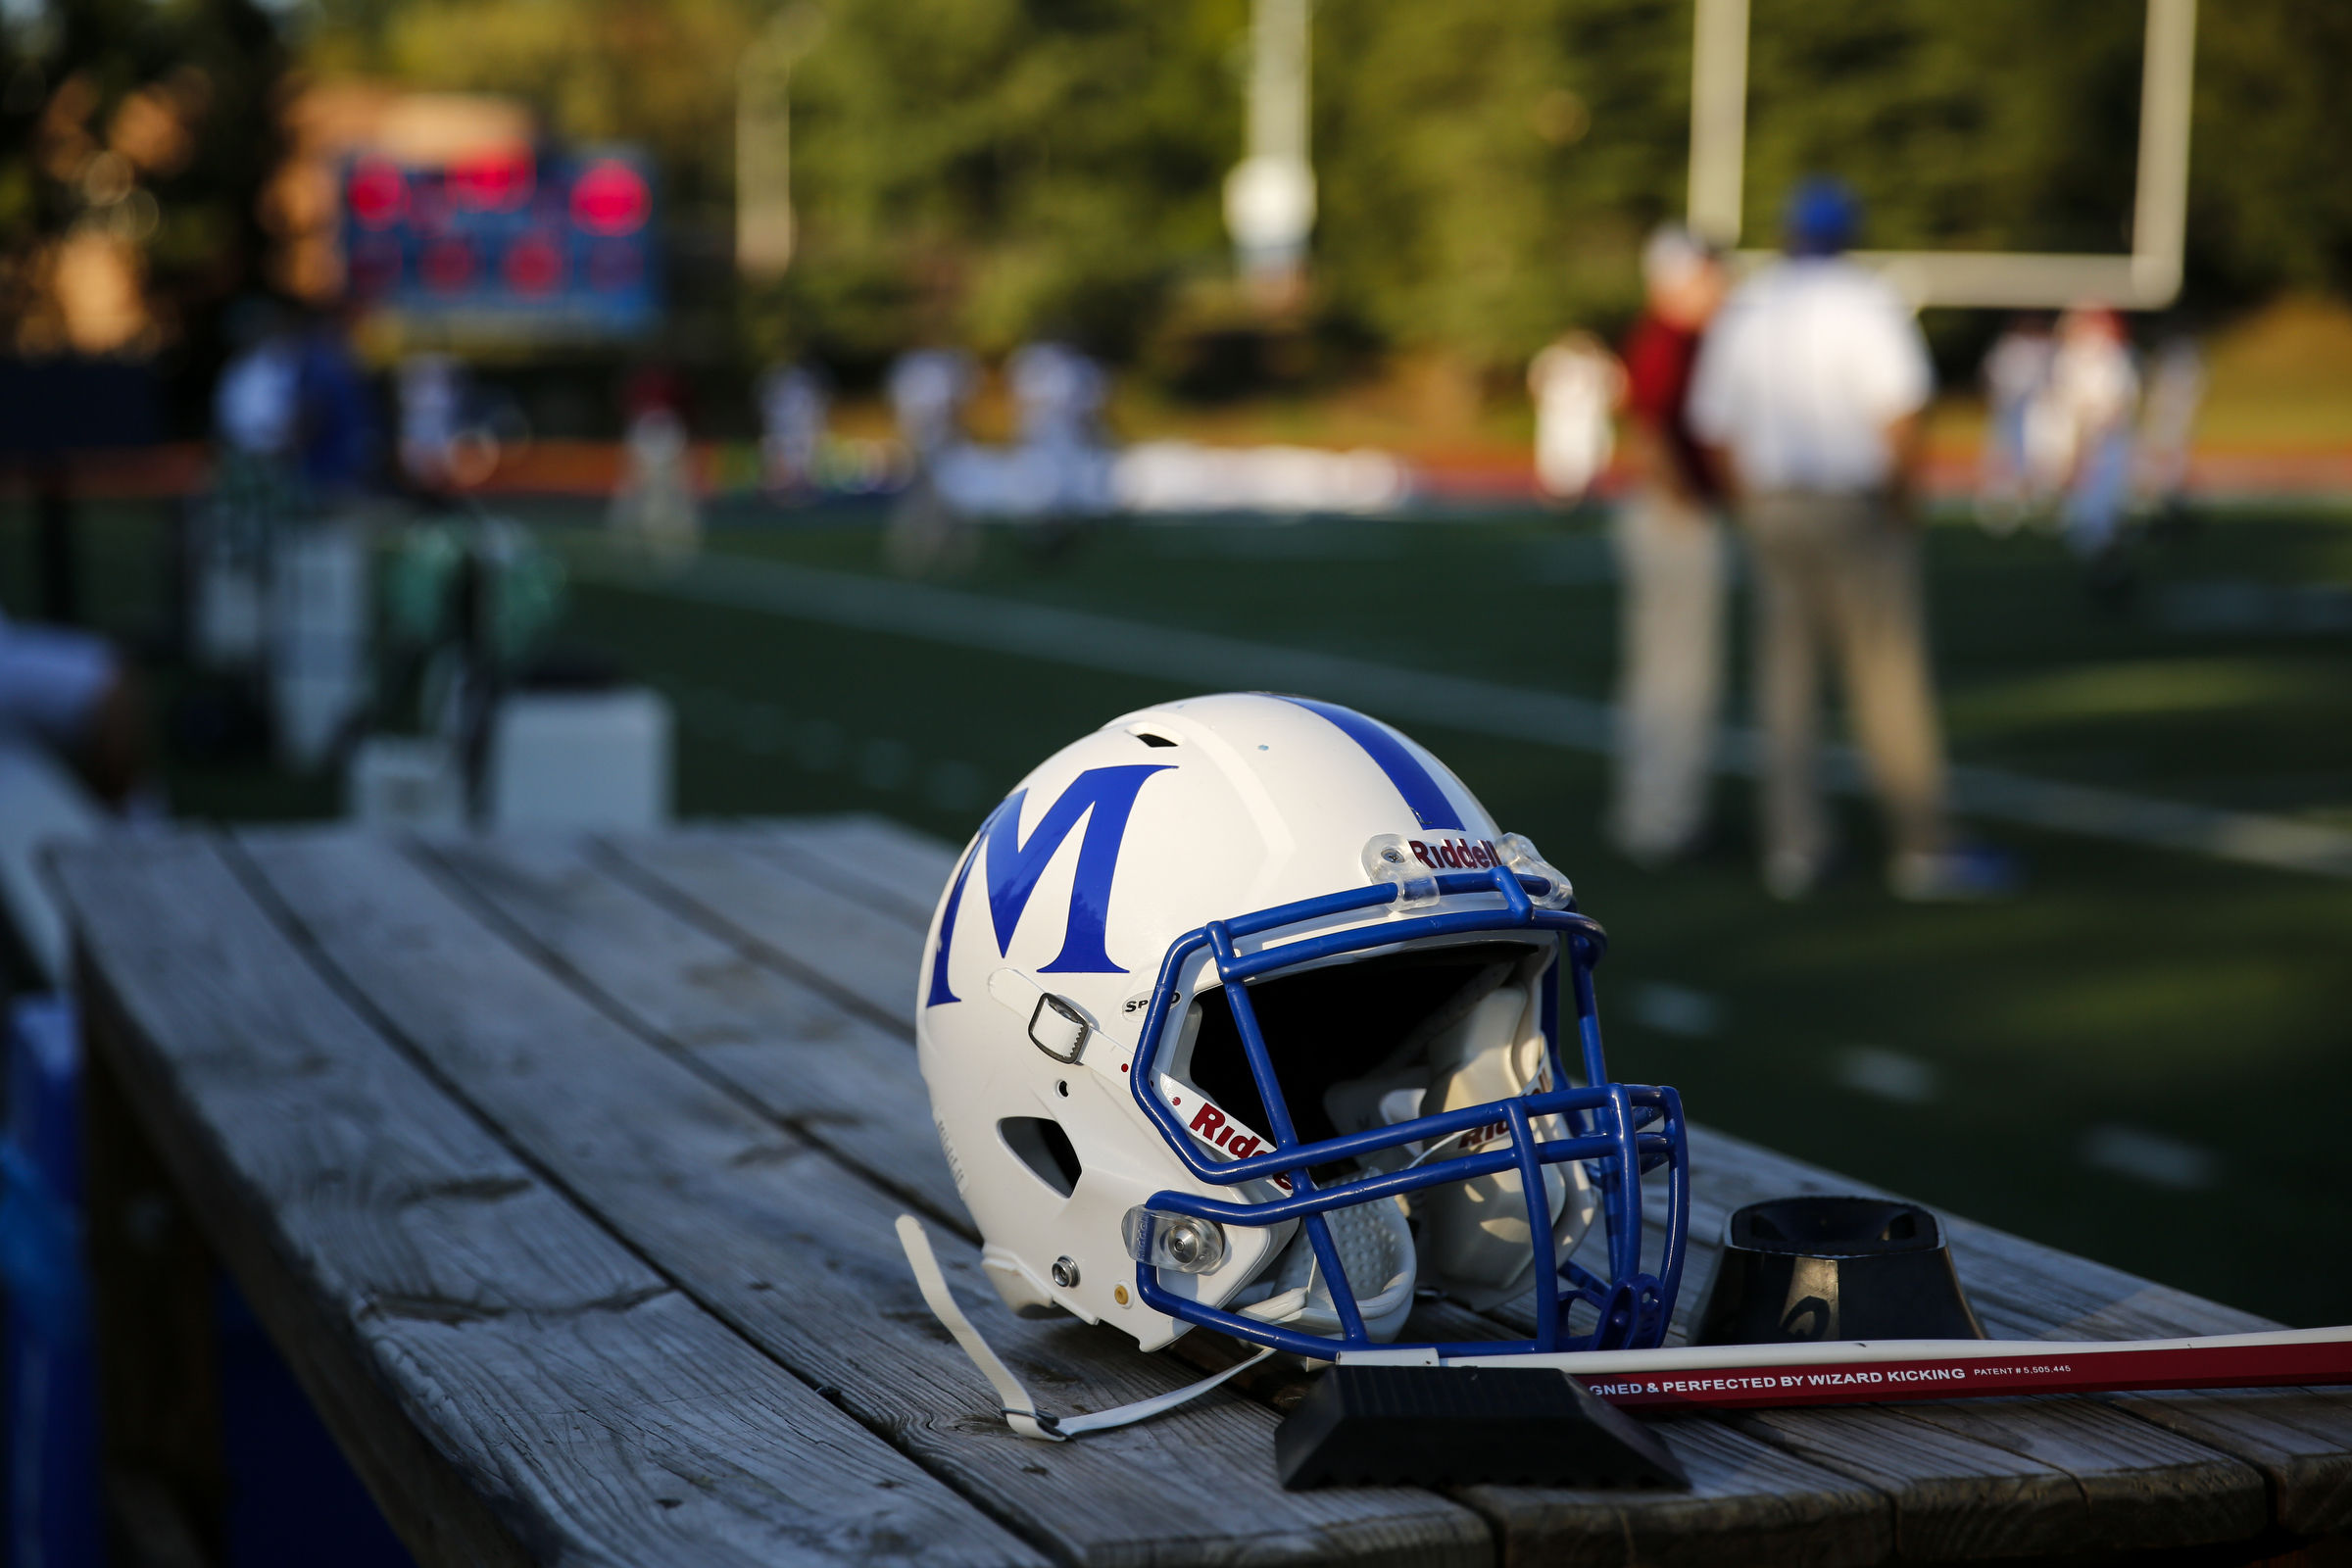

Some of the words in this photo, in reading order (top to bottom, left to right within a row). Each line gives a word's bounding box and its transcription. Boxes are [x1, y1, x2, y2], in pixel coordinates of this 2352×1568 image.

[1408, 838, 1503, 869] Riddell
[926, 764, 1179, 1007] M
[1646, 1382, 1660, 1394] &
[1663, 1376, 1777, 1393] PERFECTED
[1781, 1374, 1804, 1387] BY
[1807, 1371, 1883, 1386] WIZARD
[1887, 1368, 1966, 1382] KICKING
[1973, 1367, 2014, 1376] PATENT
